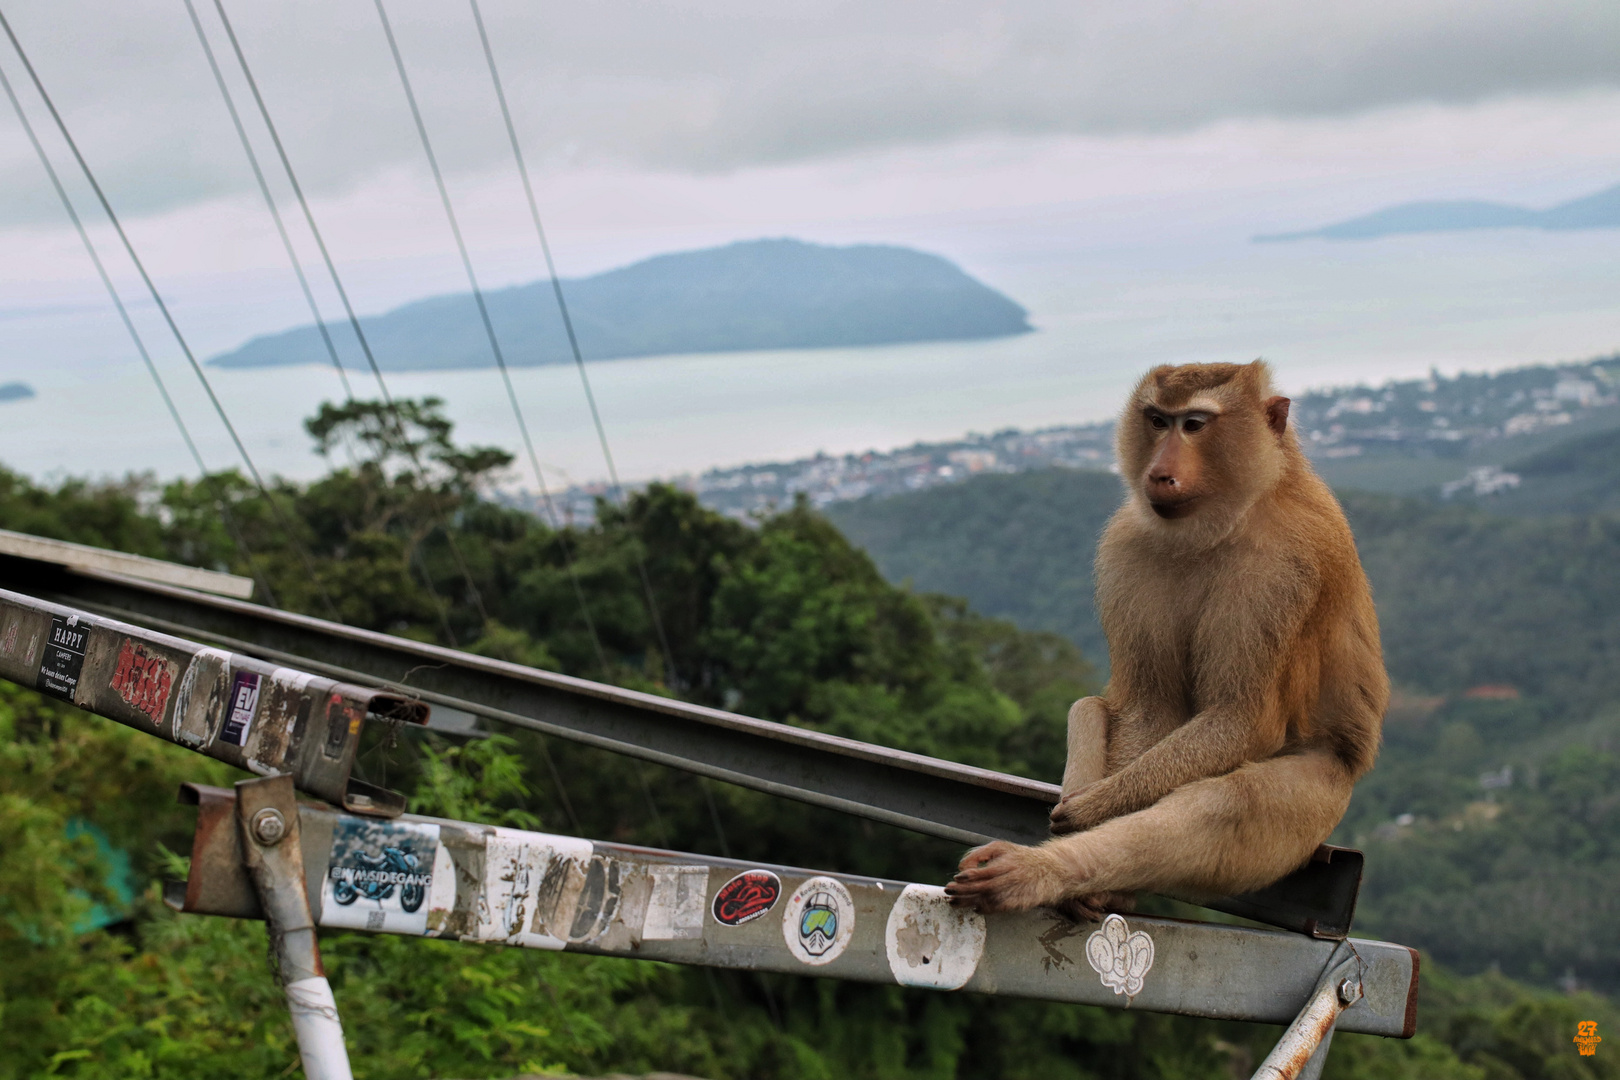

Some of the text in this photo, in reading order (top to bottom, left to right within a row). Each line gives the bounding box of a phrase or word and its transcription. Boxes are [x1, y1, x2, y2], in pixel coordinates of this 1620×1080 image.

[54, 627, 82, 649] HAPPY
[719, 873, 769, 900] Moto Shop
